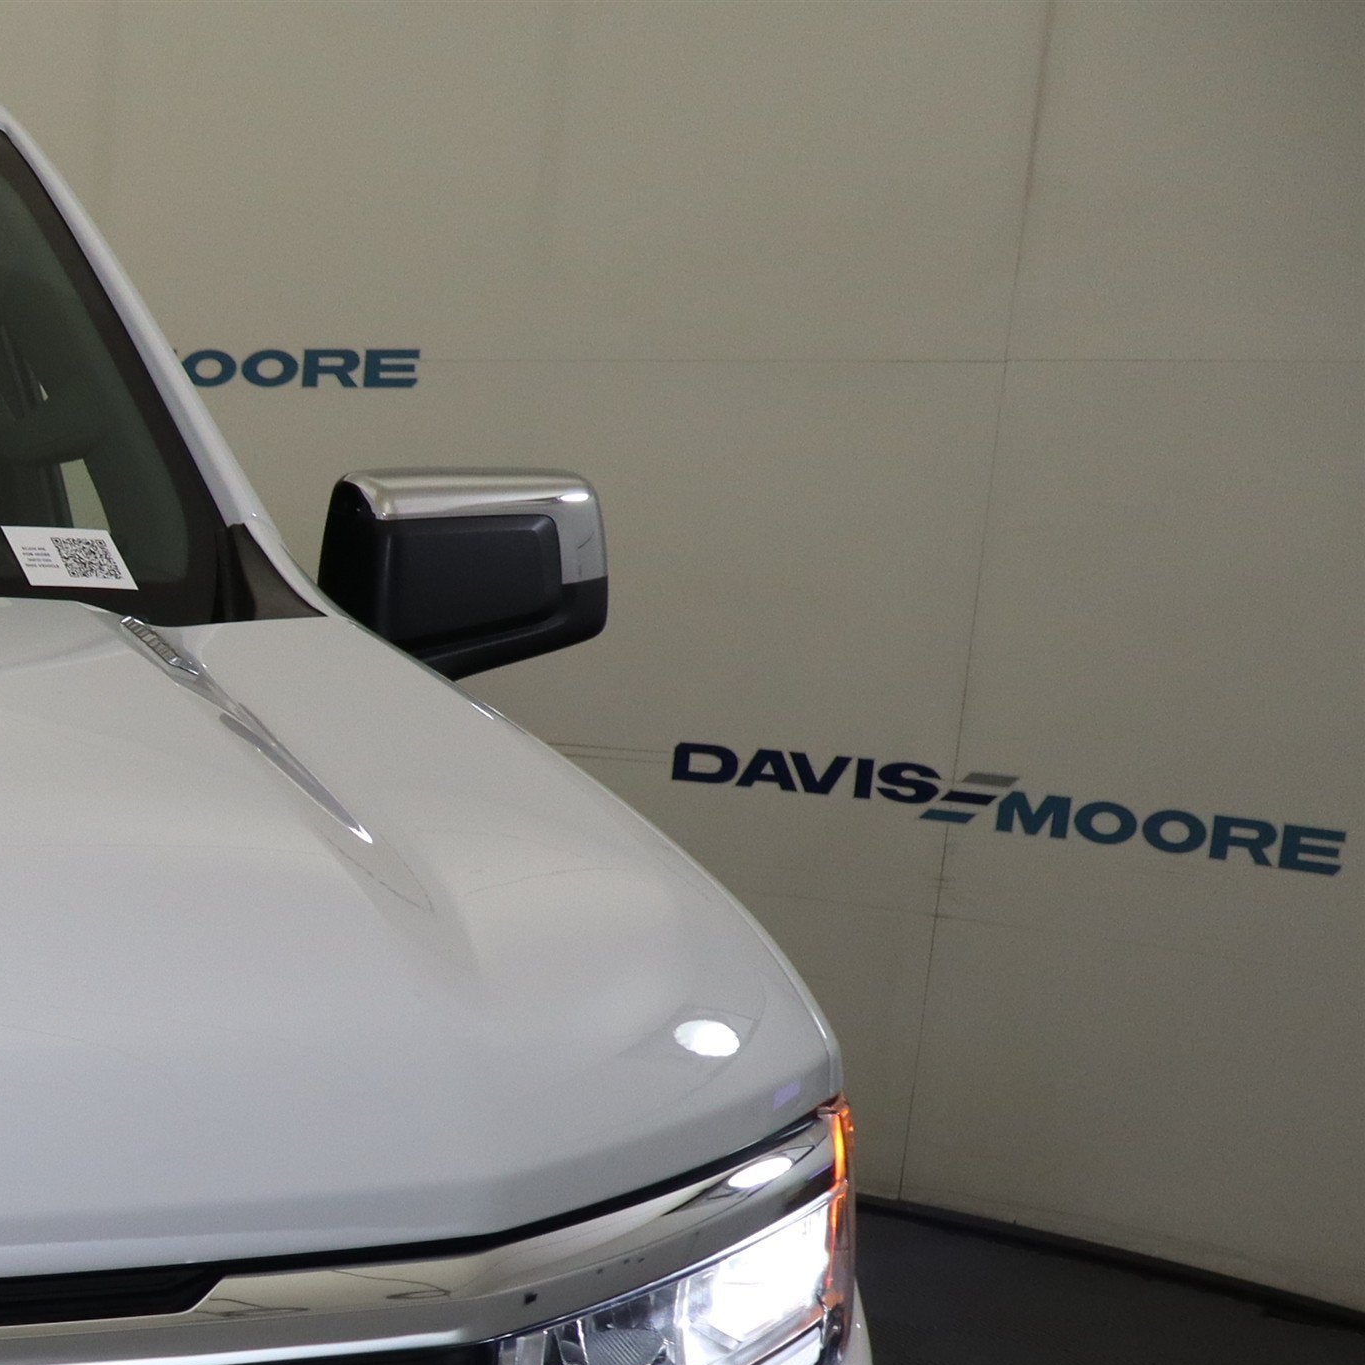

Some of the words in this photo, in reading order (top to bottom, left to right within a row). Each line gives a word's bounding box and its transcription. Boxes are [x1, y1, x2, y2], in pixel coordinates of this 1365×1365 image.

[173, 348, 421, 388] OORE
[671, 742, 943, 803] DAVIS
[995, 791, 1346, 876] MOORE
